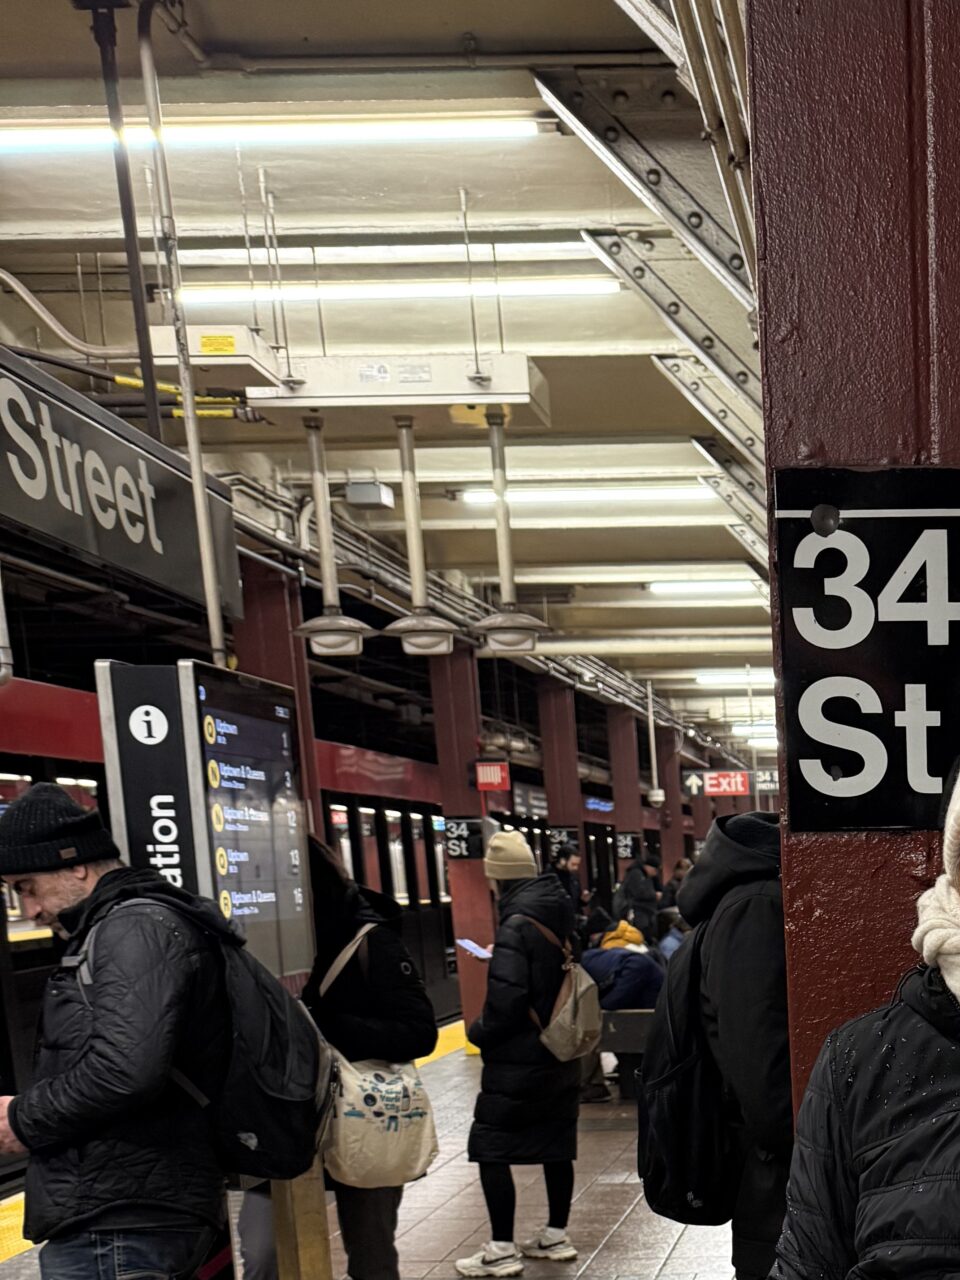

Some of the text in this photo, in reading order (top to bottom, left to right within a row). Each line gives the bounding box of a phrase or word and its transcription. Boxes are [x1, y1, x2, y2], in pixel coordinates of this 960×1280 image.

[0, 377, 164, 555] Street
[797, 675, 943, 798] St
[705, 771, 745, 792] Exit
[445, 822, 470, 838] 34
[446, 840, 469, 856] St
[616, 834, 633, 847] 34
